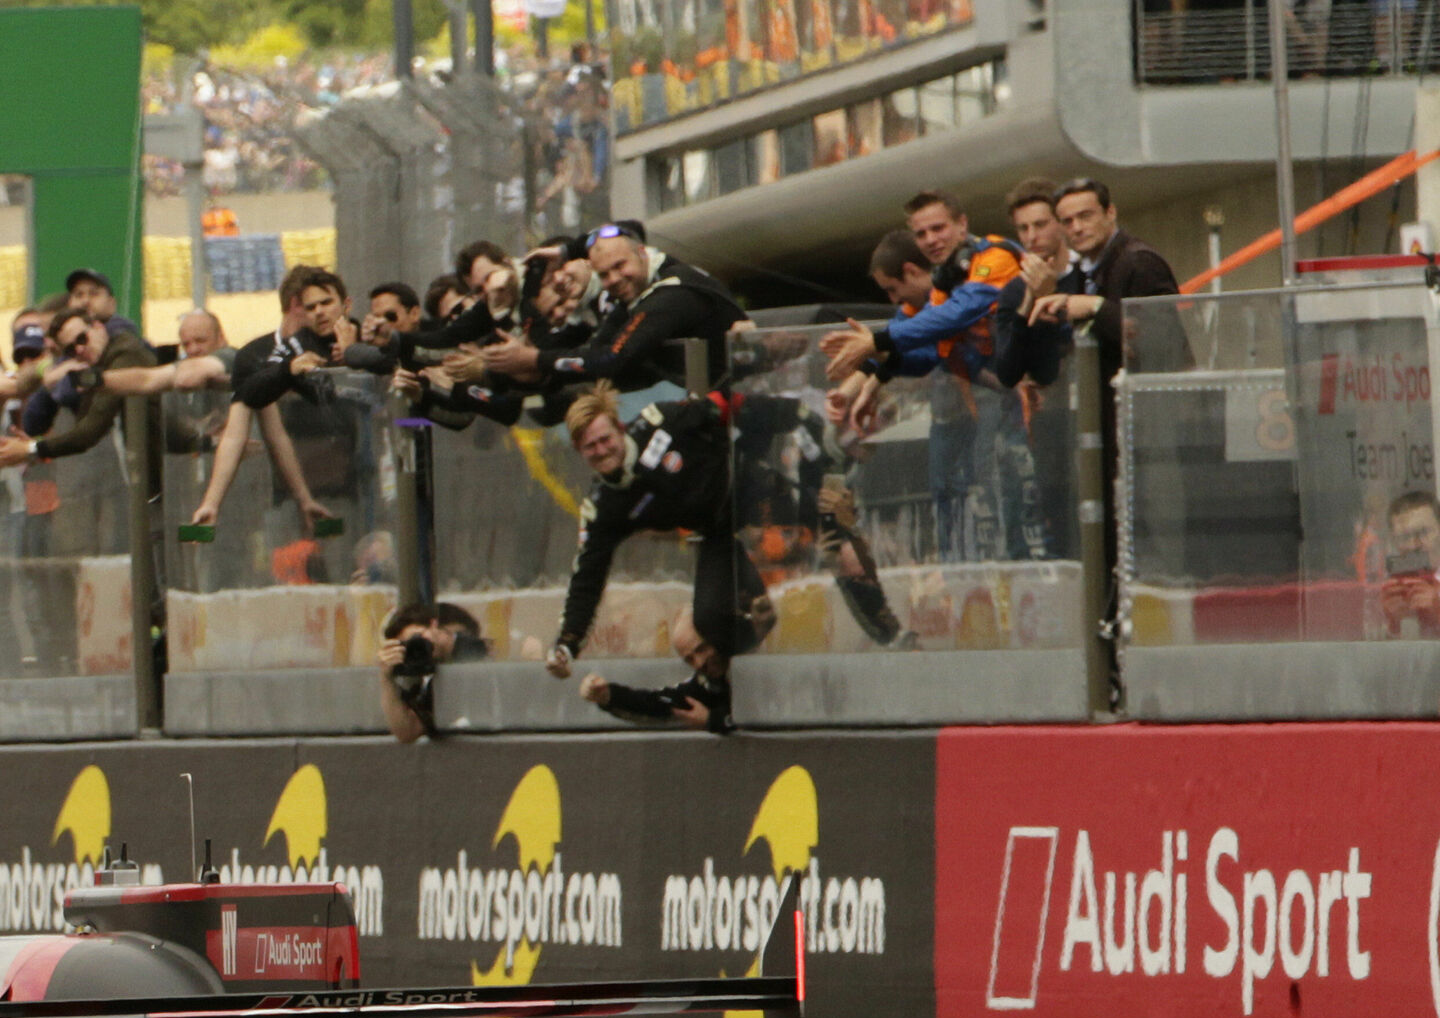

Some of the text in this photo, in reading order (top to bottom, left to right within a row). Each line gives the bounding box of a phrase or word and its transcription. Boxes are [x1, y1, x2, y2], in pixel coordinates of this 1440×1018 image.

[1344, 354, 1387, 401] Audi
[1346, 430, 1397, 479] Team
[418, 849, 622, 969] motorsport.com
[1060, 827, 1372, 1016] Audi Sport
[222, 910, 237, 975] HY
[269, 933, 322, 973] Audi Sport
[297, 991, 478, 1008] Audi Sport
